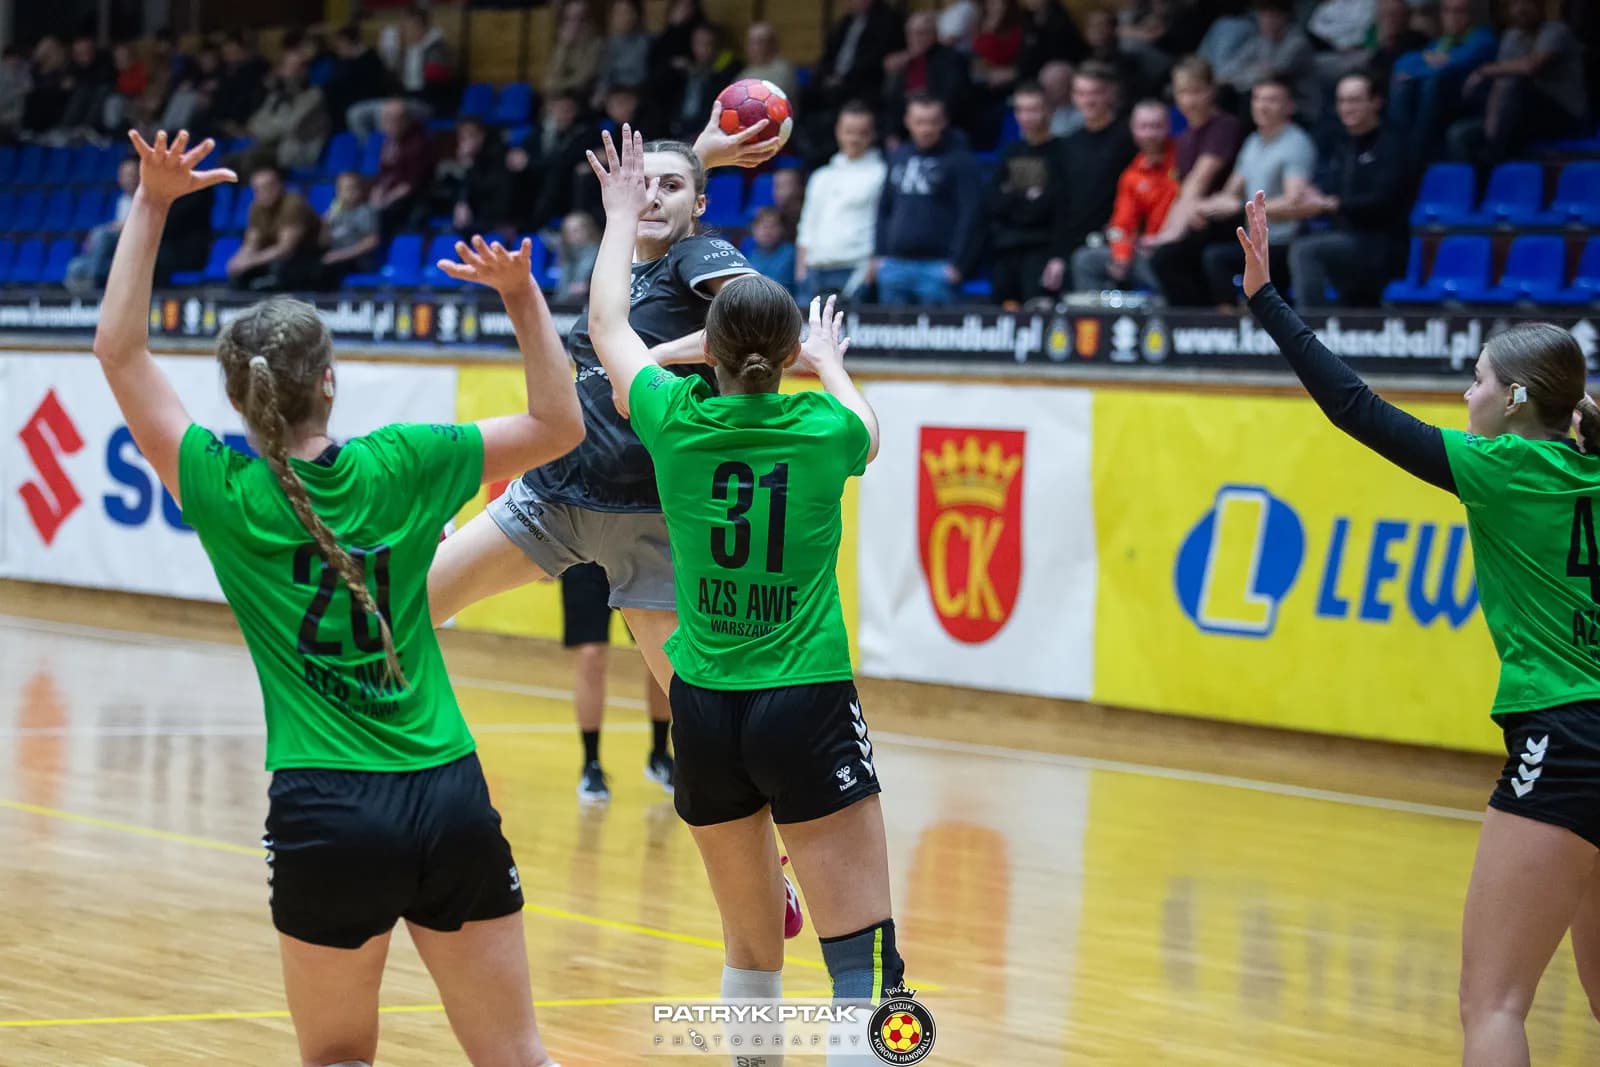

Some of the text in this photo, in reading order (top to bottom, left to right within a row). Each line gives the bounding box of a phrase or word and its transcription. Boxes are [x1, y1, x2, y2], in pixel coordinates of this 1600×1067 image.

[710, 461, 790, 574] 31
[698, 577, 799, 623] AZS AWF
[1315, 517, 1479, 632] LEW
[1573, 608, 1600, 646] AZ
